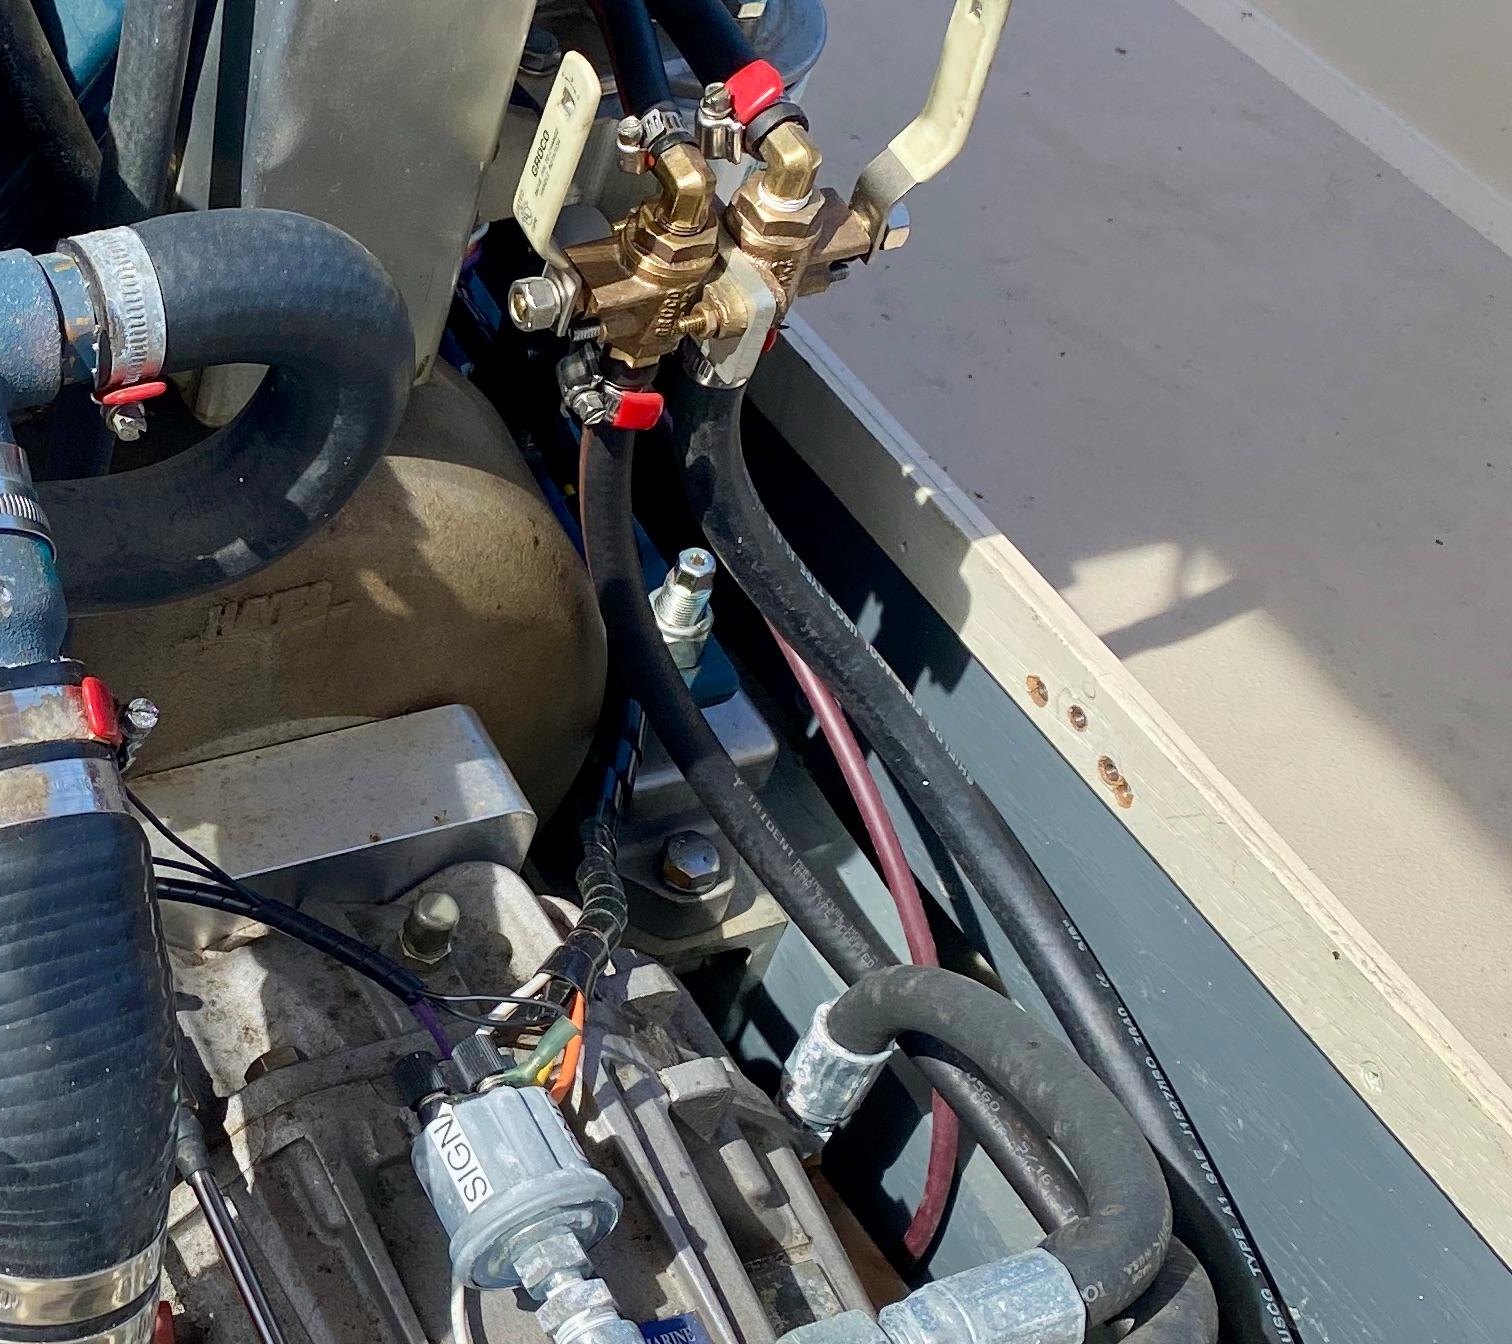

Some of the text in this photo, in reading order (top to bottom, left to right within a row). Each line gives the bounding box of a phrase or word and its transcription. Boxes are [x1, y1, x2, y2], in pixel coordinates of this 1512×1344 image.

[747, 793, 795, 858] TRIDENT
[1193, 1149, 1219, 1185] SAE
[1217, 1195, 1236, 1218] A1
[1232, 1227, 1262, 1277] TYPE
[1260, 1288, 1292, 1344] USCG
